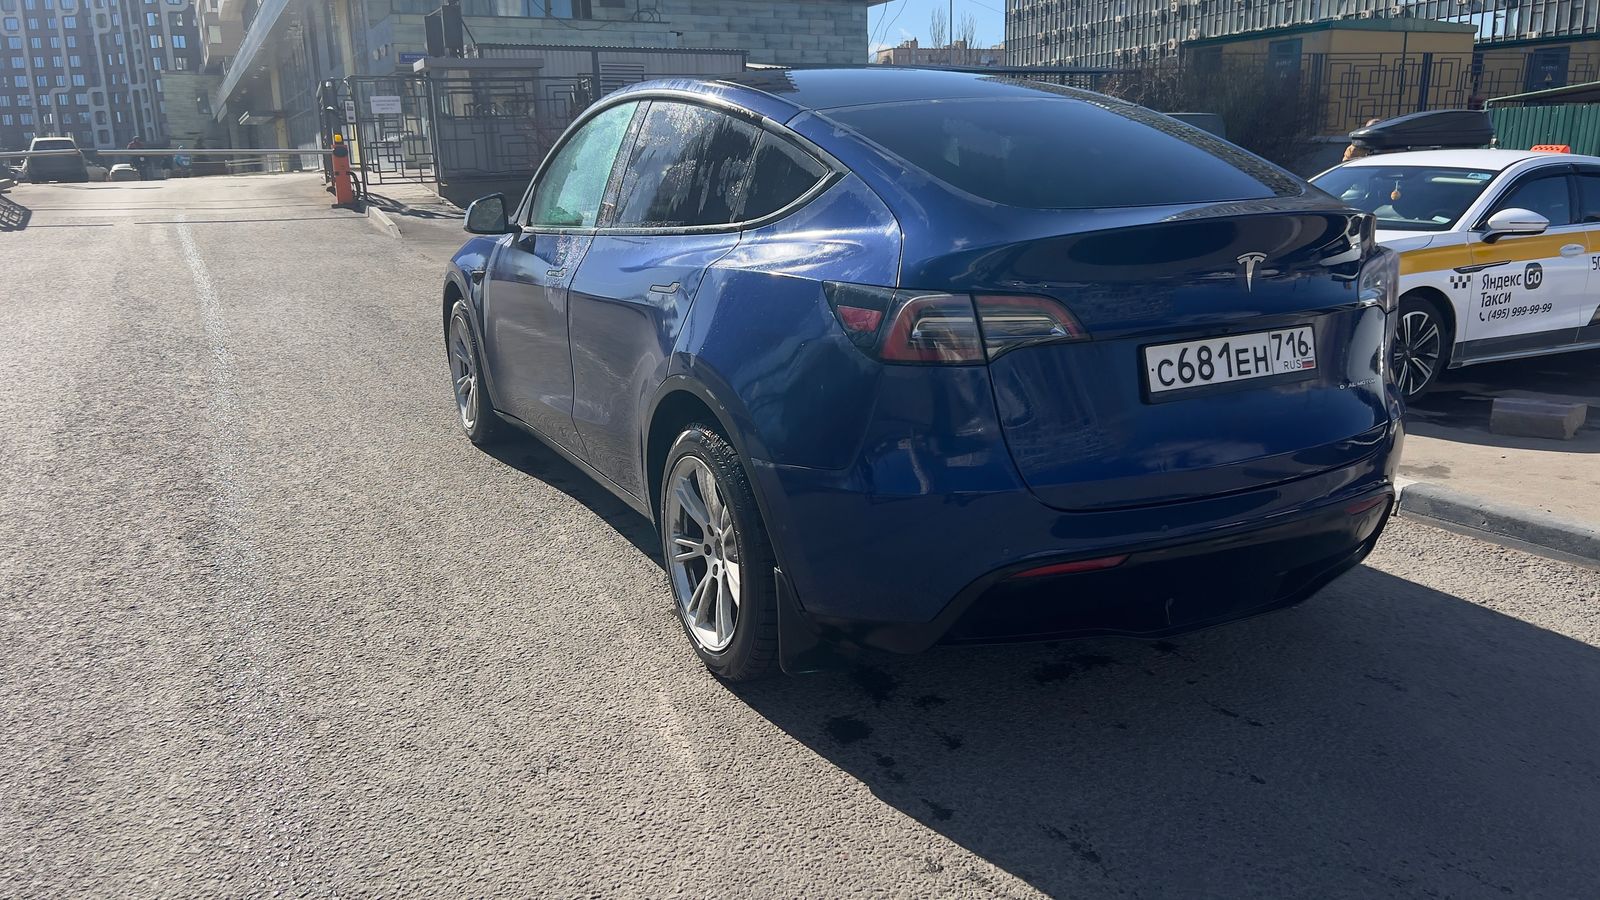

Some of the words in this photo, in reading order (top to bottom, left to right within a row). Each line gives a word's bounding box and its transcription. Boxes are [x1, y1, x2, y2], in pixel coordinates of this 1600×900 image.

[1482, 274, 1521, 290] Яндекс
[1526, 268, 1541, 285] Go
[1481, 292, 1511, 308] Такси
[1488, 308, 1510, 321] (495)
[1511, 302, 1553, 317] 999-99-99
[1271, 331, 1309, 361] 716
[1283, 360, 1301, 370] RUS
